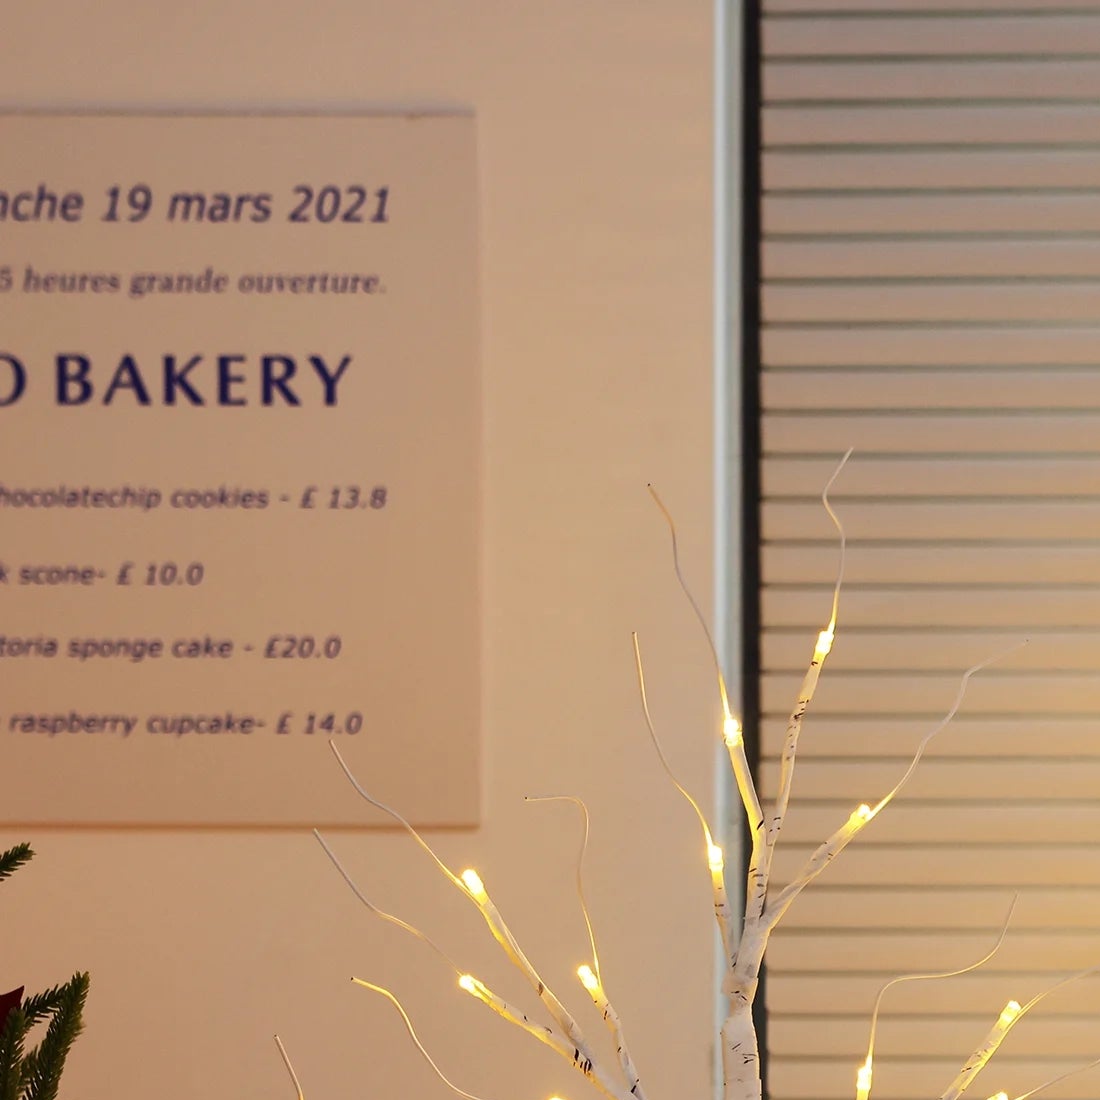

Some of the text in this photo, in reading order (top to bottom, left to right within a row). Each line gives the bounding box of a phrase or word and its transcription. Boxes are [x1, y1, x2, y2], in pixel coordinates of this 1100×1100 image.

[101, 183, 153, 223] 19
[166, 191, 273, 224] mars
[287, 184, 389, 224] 2021
[22, 265, 120, 294] heures
[128, 267, 229, 299] grande
[54, 352, 352, 407] BAKERY
[170, 485, 270, 510] cookies
[328, 485, 388, 510] 13.8
[144, 561, 205, 587] 10.0
[66, 637, 164, 664] sponge
[170, 636, 234, 659] cake
[263, 634, 342, 660] £20.0
[8, 710, 138, 738] raspberry
[303, 711, 364, 736] 14.0
